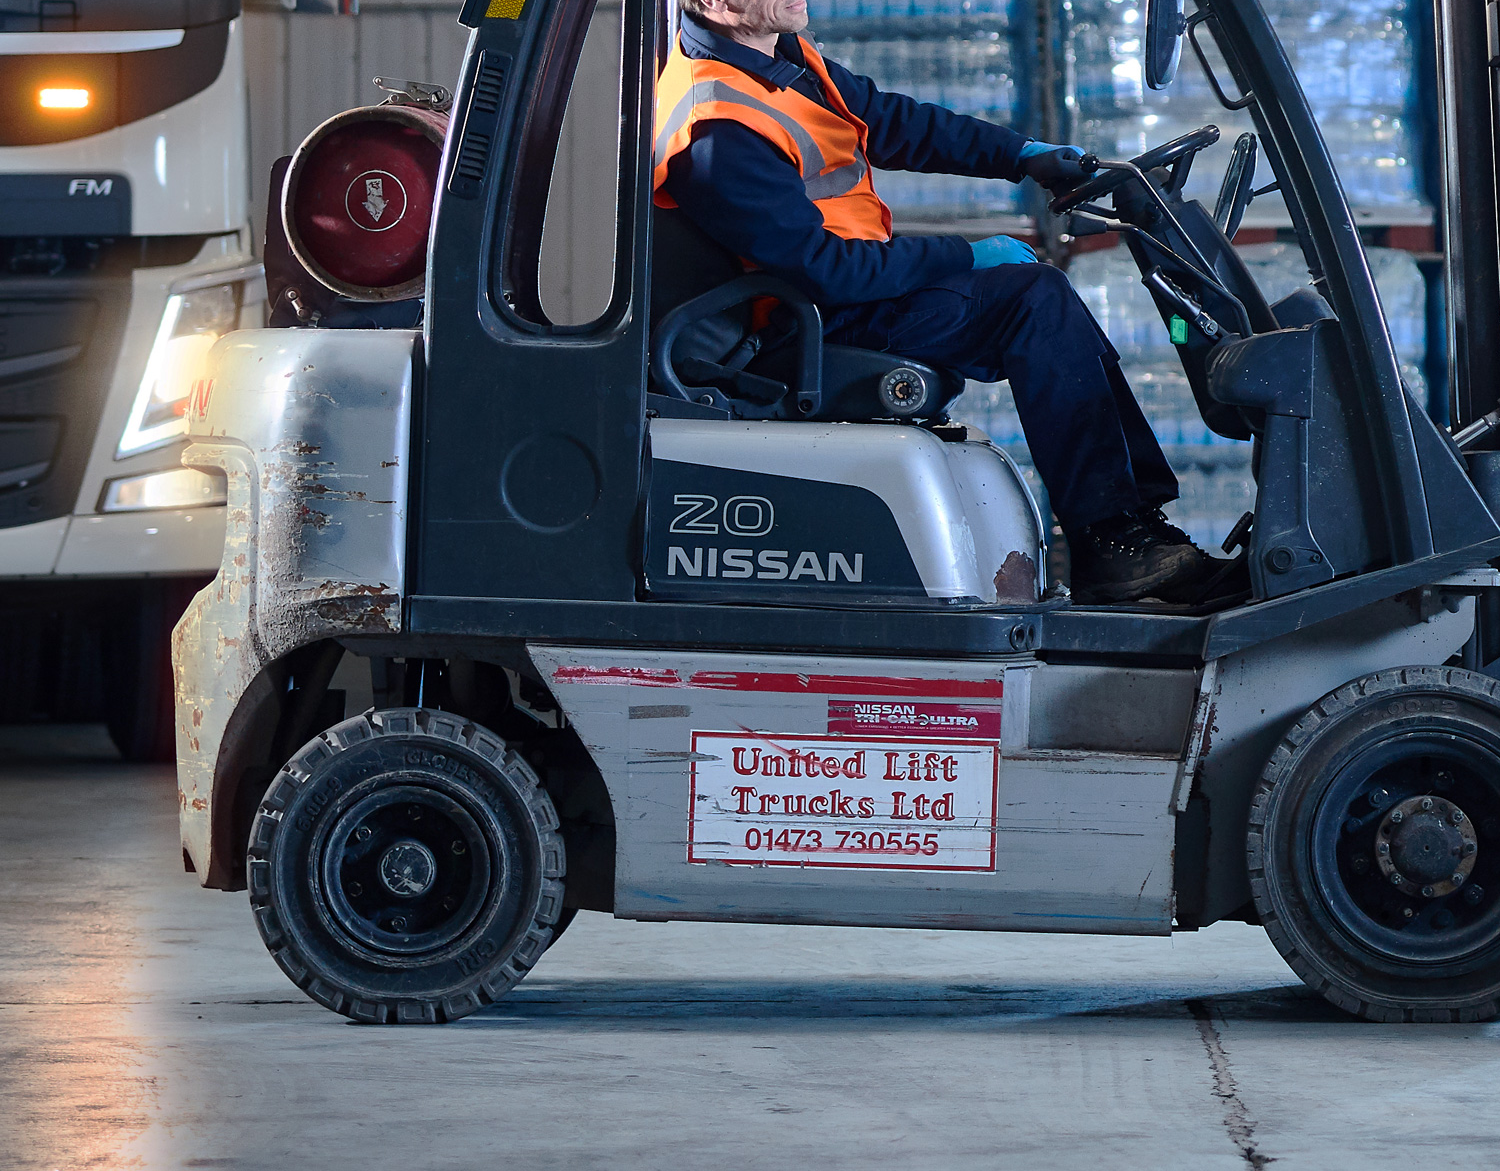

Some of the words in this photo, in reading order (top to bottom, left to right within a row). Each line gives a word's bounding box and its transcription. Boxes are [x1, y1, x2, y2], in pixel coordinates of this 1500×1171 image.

[68, 179, 113, 196] FM
[669, 493, 775, 537] 20
[667, 546, 864, 584] NISSAN
[854, 703, 915, 715] NISSAN
[929, 715, 979, 726] ULTRA
[732, 747, 868, 780] United
[884, 751, 959, 783] Lift
[731, 786, 875, 819] Trucks
[891, 792, 956, 821] Ltd
[744, 827, 822, 853] 01473
[835, 829, 940, 858] 730555
